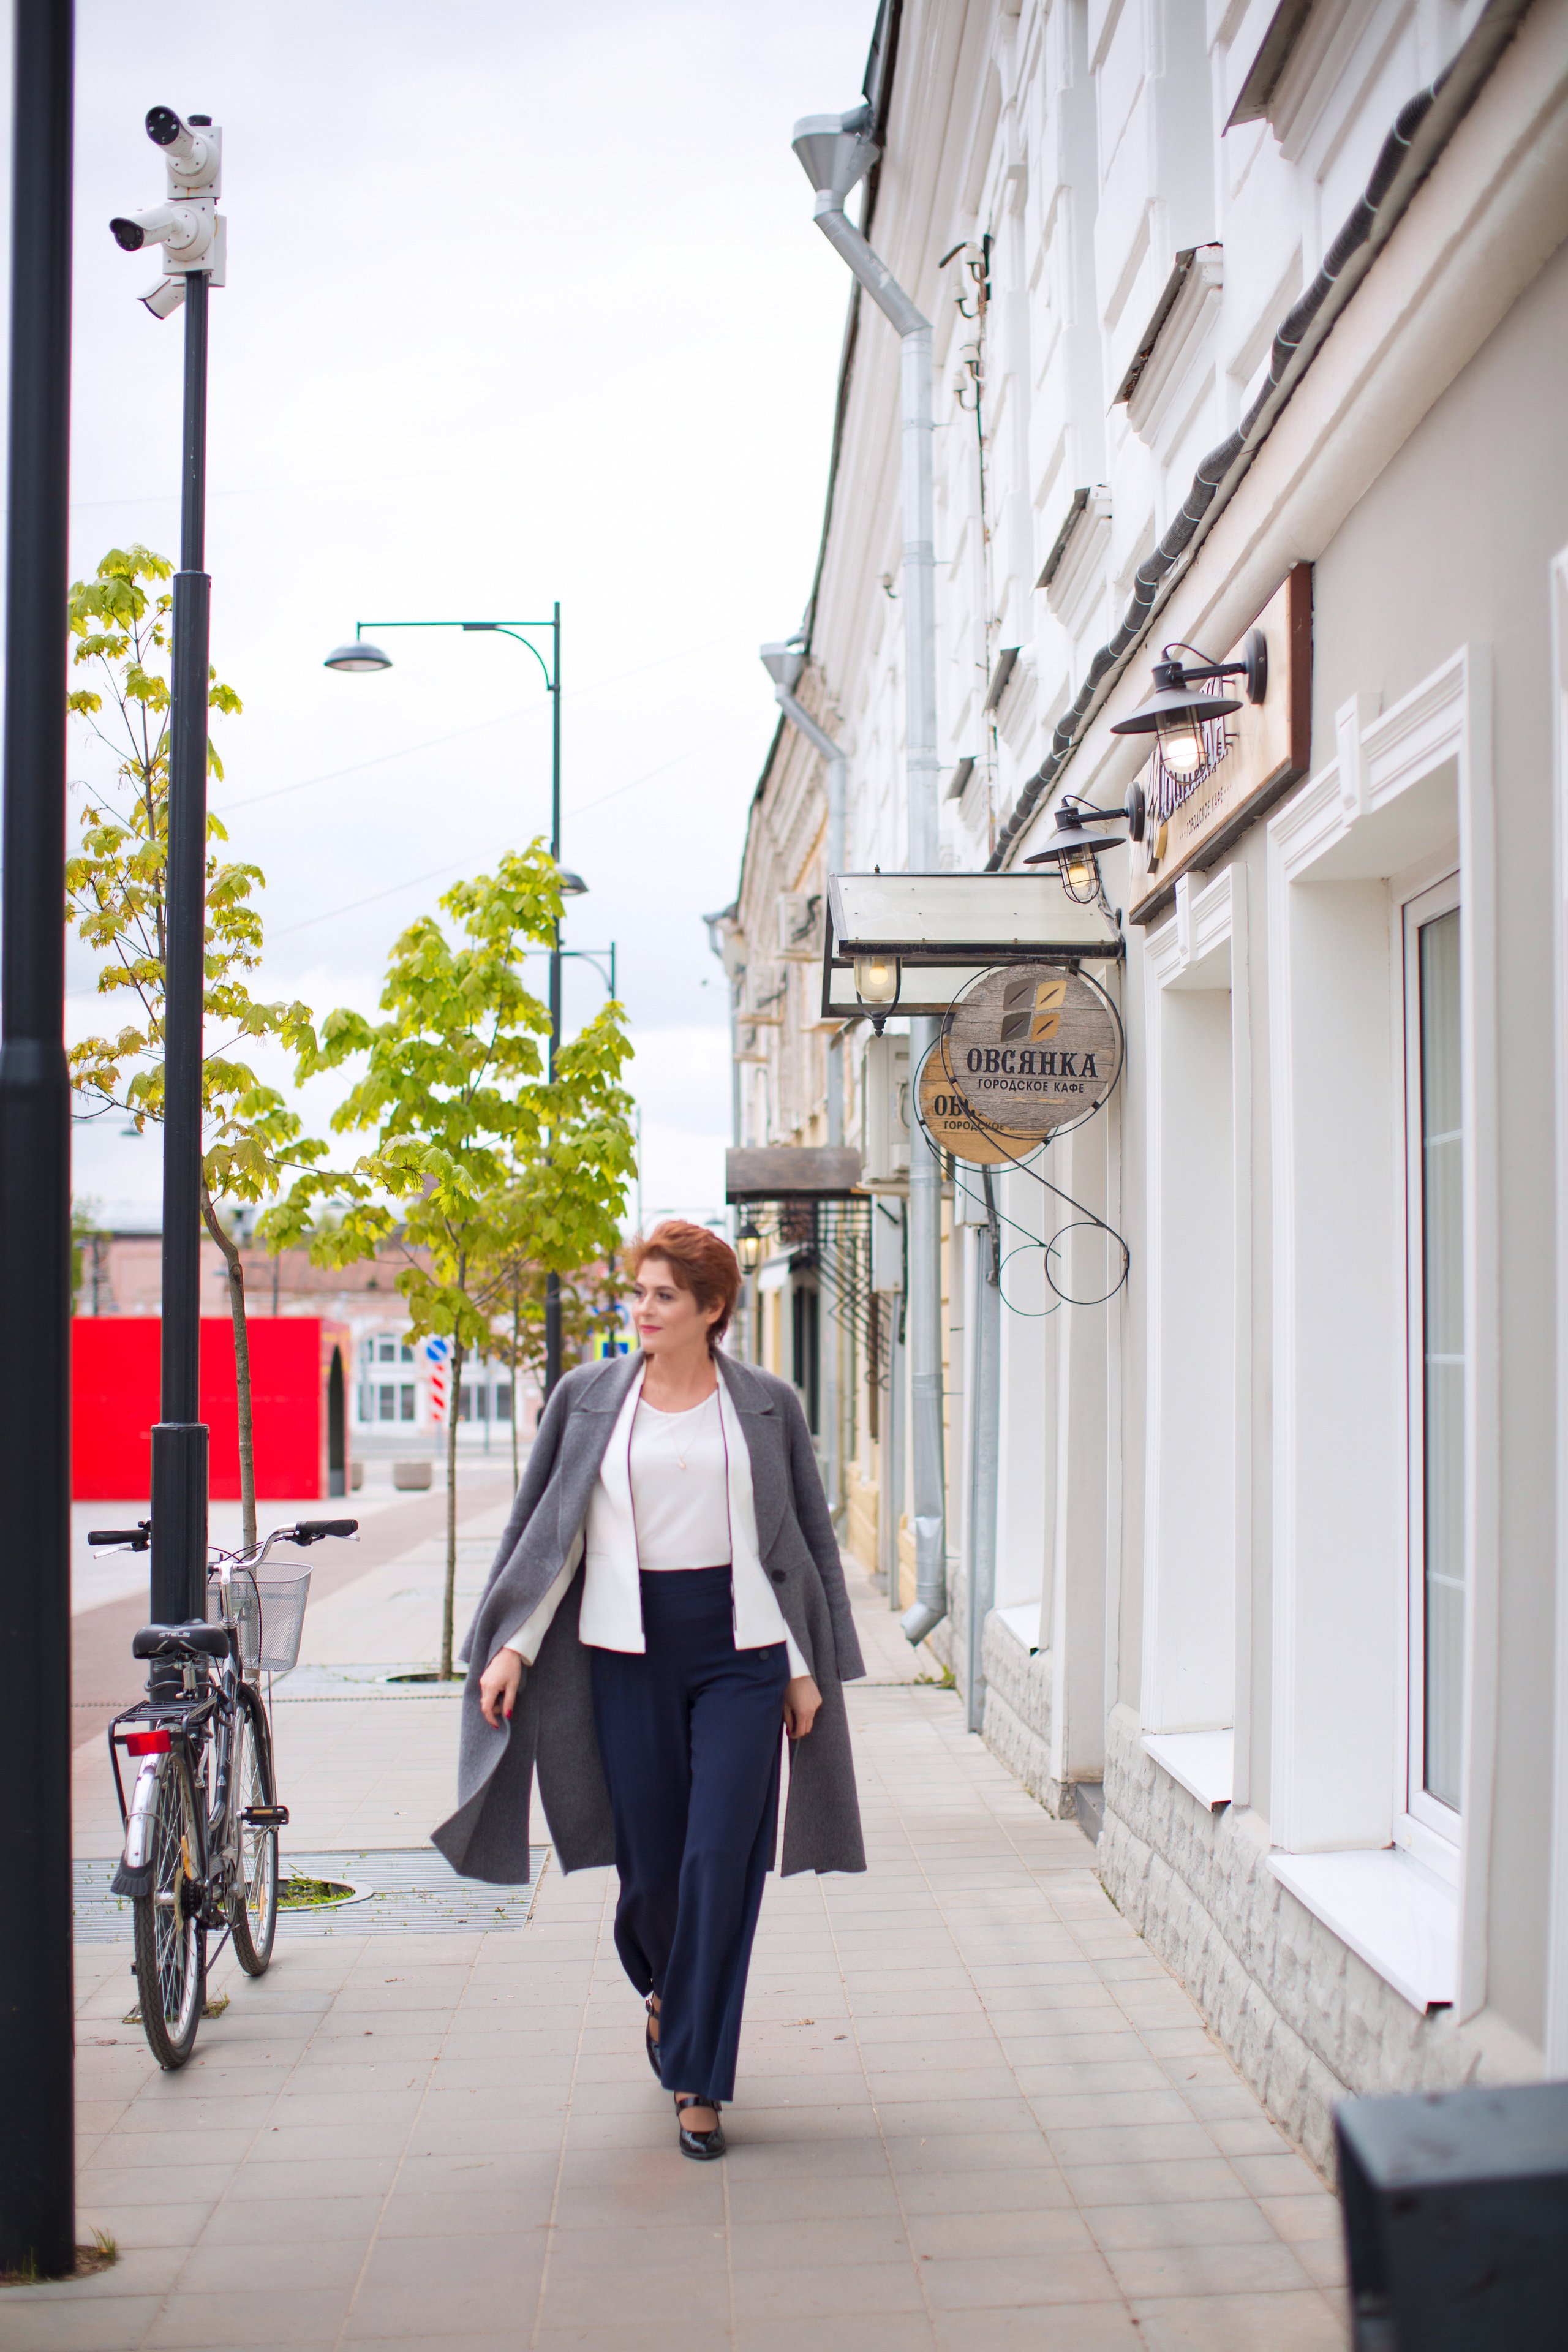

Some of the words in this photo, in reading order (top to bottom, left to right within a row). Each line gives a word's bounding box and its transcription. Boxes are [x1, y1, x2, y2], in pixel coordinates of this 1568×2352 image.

[967, 1047, 1099, 1078] ОВСЯНКА
[978, 1079, 1049, 1092] ГОРОДСКОЕ
[1054, 1082, 1085, 1093] КАФЕ
